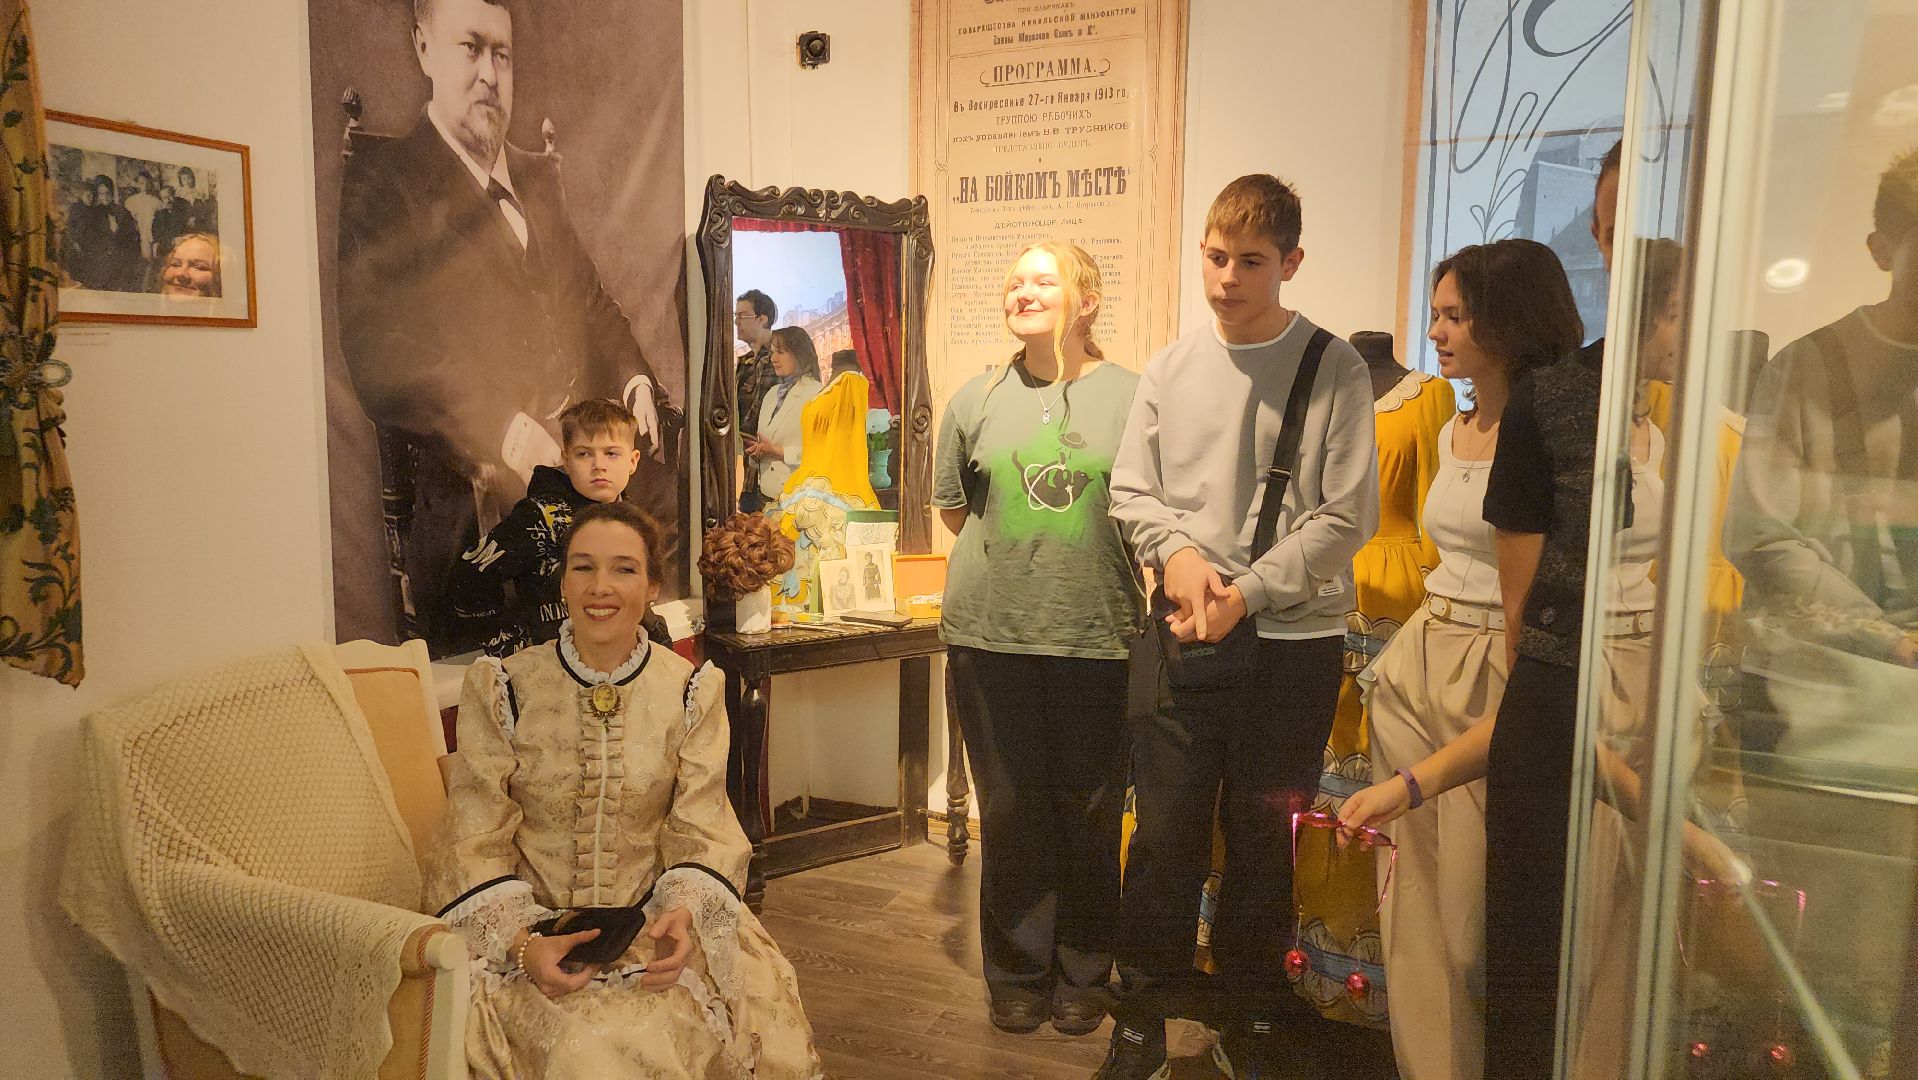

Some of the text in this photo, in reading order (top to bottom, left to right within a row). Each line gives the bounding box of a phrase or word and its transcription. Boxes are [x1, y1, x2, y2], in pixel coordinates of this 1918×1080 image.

[993, 57, 1097, 82] ПРОГРАММА.
[1057, 91, 1090, 104] Января
[1094, 87, 1114, 101] 1913
[995, 109, 1092, 126] ТРУППОЮ РАБОЧИХЪ
[985, 171, 1061, 201] БОЙКОМЪ
